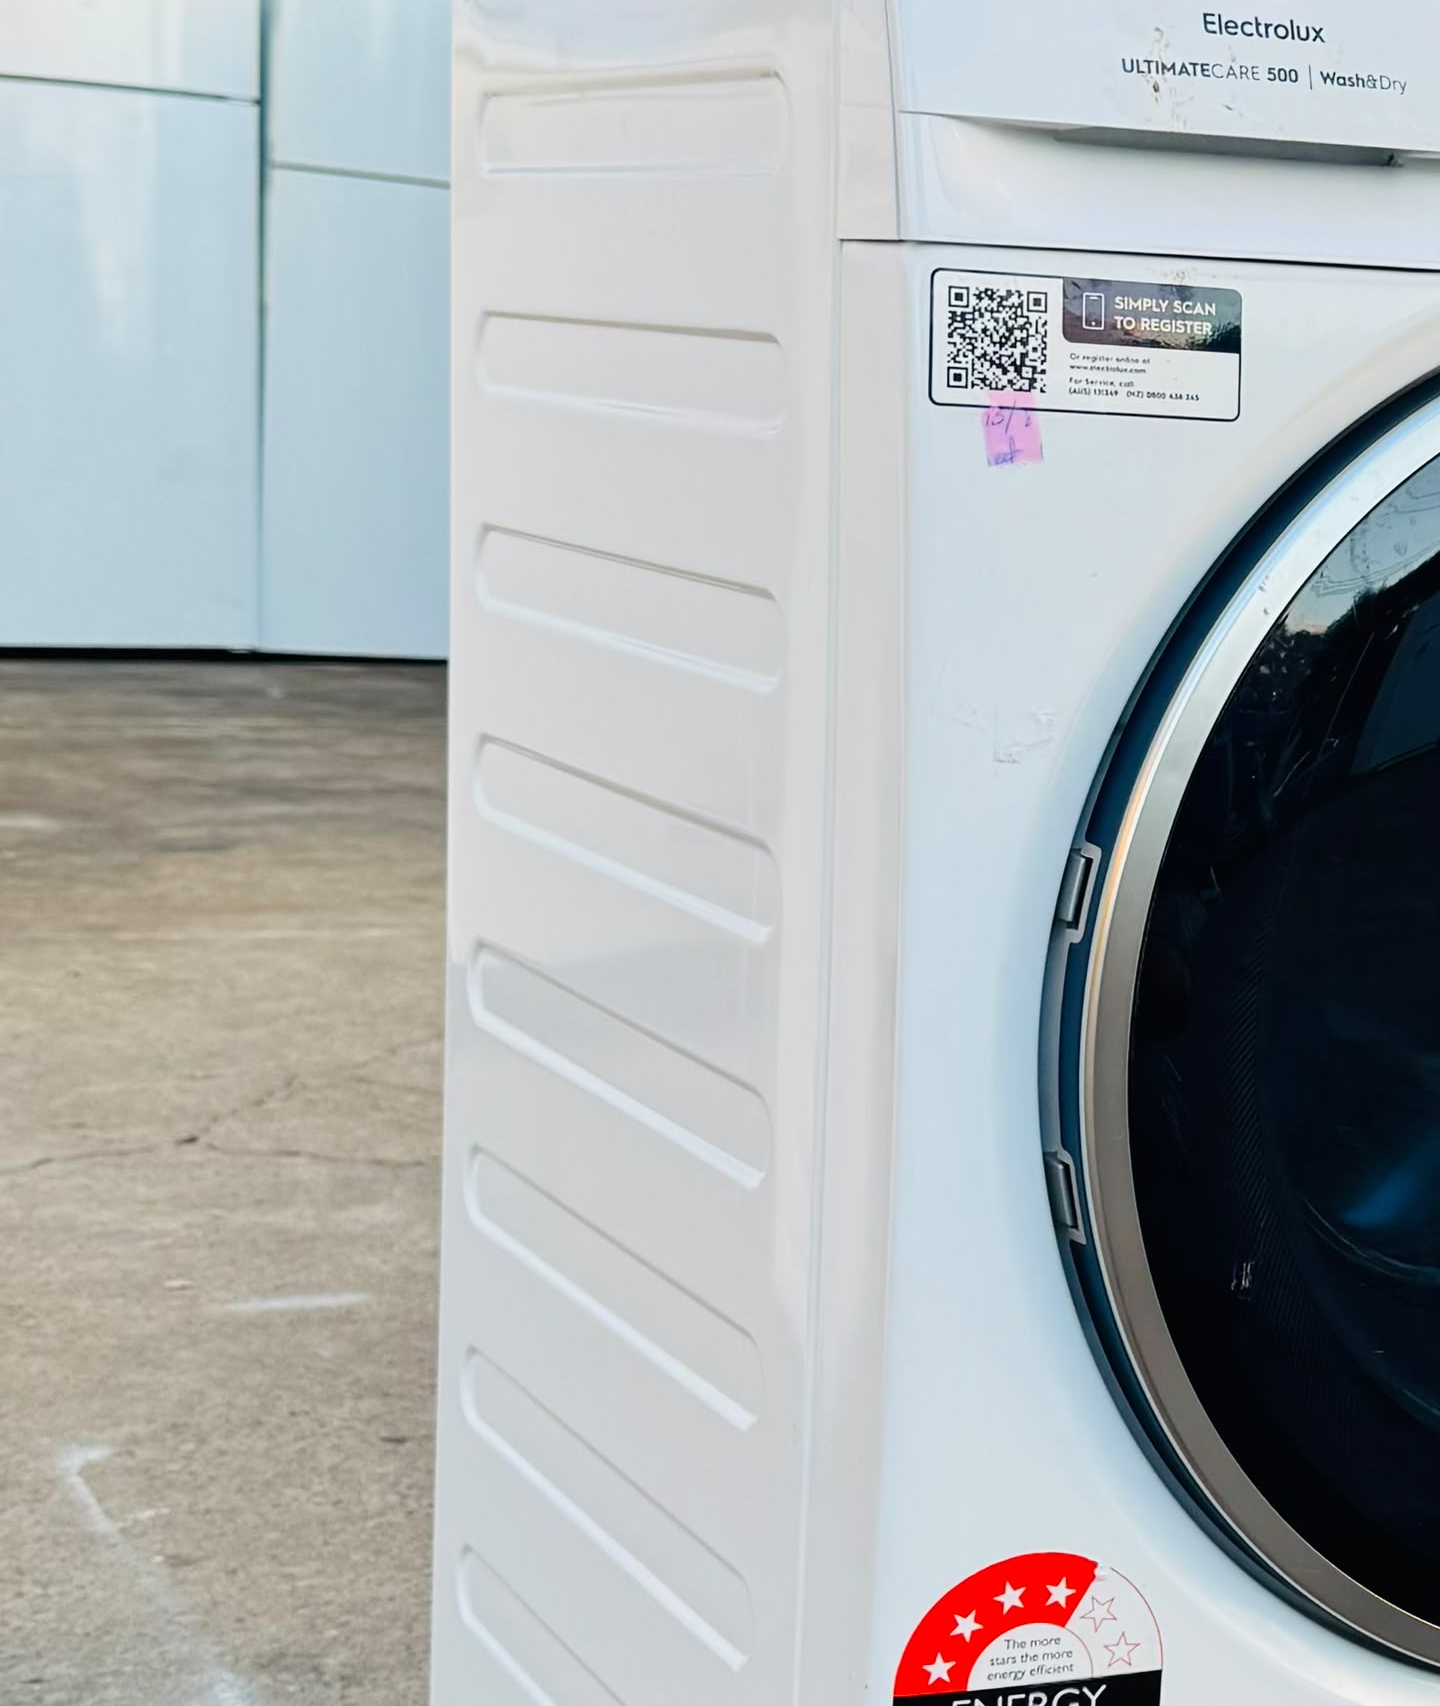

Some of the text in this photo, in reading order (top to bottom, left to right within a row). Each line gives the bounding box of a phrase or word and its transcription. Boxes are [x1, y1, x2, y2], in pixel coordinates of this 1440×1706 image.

[1203, 13, 1325, 43] Electrolux
[1121, 58, 1407, 95] ULTIMATECARE 500 Wash&Dry
[1115, 296, 1216, 316] SIMPLY SCAN
[1114, 315, 1213, 335] TO REGISTER
[1082, 354, 1113, 363] register
[1069, 377, 1082, 385] For
[1004, 1636, 1061, 1651] The more
[990, 1649, 1073, 1666] stars the more
[987, 1663, 1074, 1681] energy efficient
